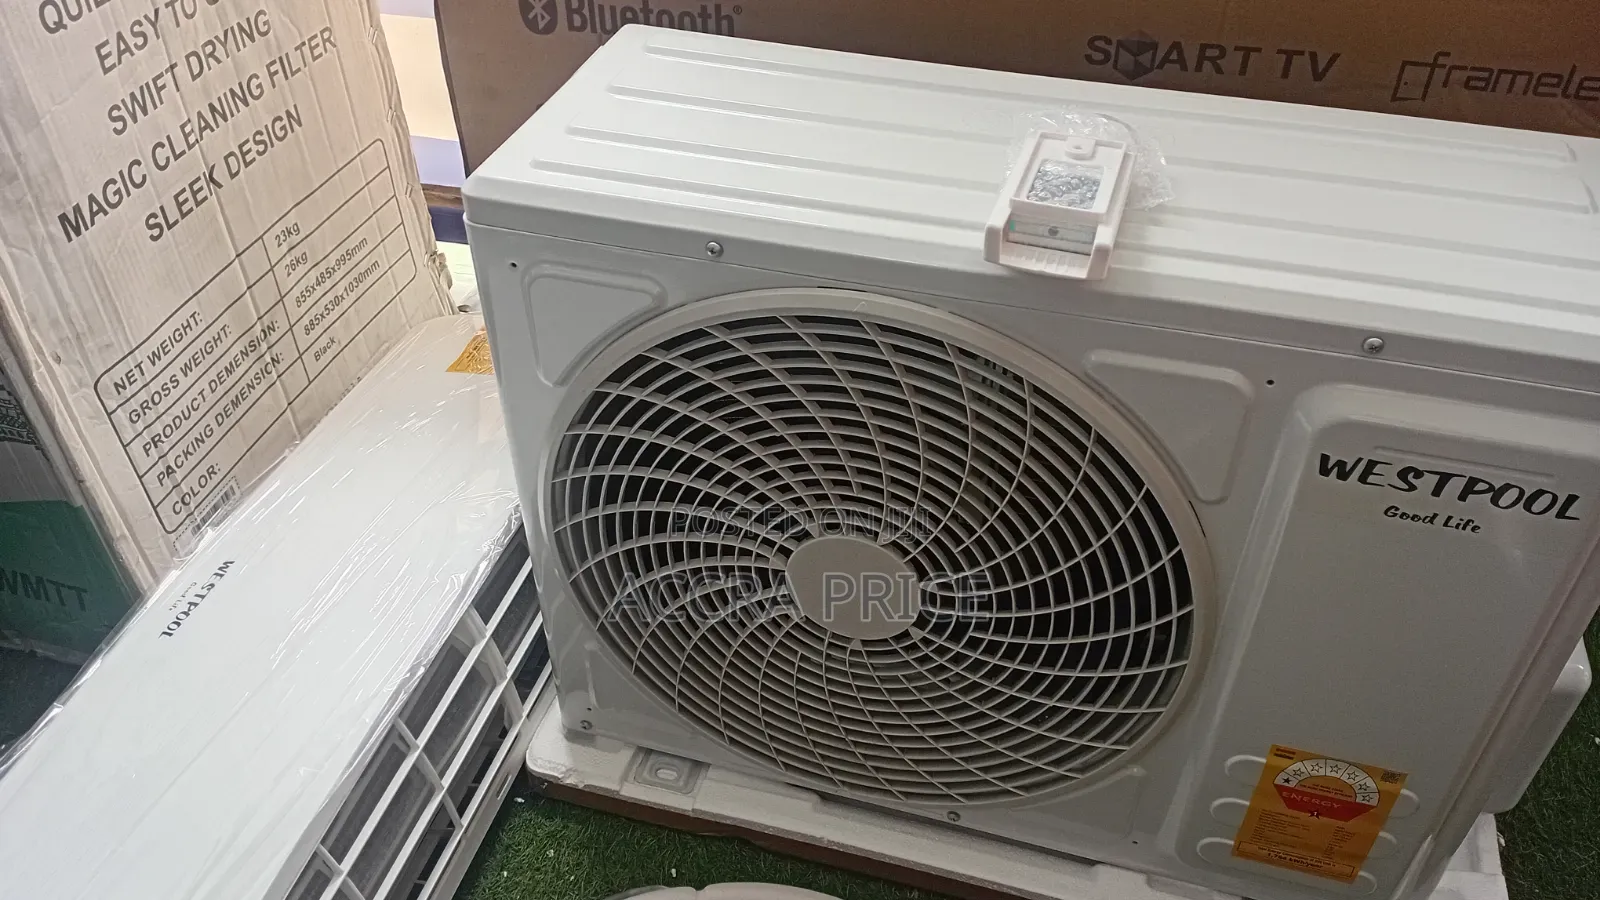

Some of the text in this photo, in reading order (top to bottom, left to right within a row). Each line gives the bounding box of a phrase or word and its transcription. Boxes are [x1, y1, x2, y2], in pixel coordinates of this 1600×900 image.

[95, 0, 198, 76] EASY TO
[107, 10, 272, 136] SWIFT DRYING
[1275, 49, 1341, 82] TV
[57, 26, 337, 243] MAGIC CLEANING FILTER
[144, 103, 303, 243] SLEEK DESIGN
[113, 221, 301, 396] NET WEIGHT: 23kg
[128, 250, 309, 425] GROSS WEIGHT: 26kg
[142, 235, 369, 457] PRODUCT DEMENSION: 855x485x995mm
[157, 258, 380, 487] PACKING DEMENSION: 885x530x1030mm
[172, 335, 337, 516] COLOR: Black
[1318, 453, 1580, 520] WESTPOOL
[1383, 505, 1481, 534] Good Life
[158, 561, 235, 639] WESTPOOL
[1281, 791, 1342, 809] ENERGY
